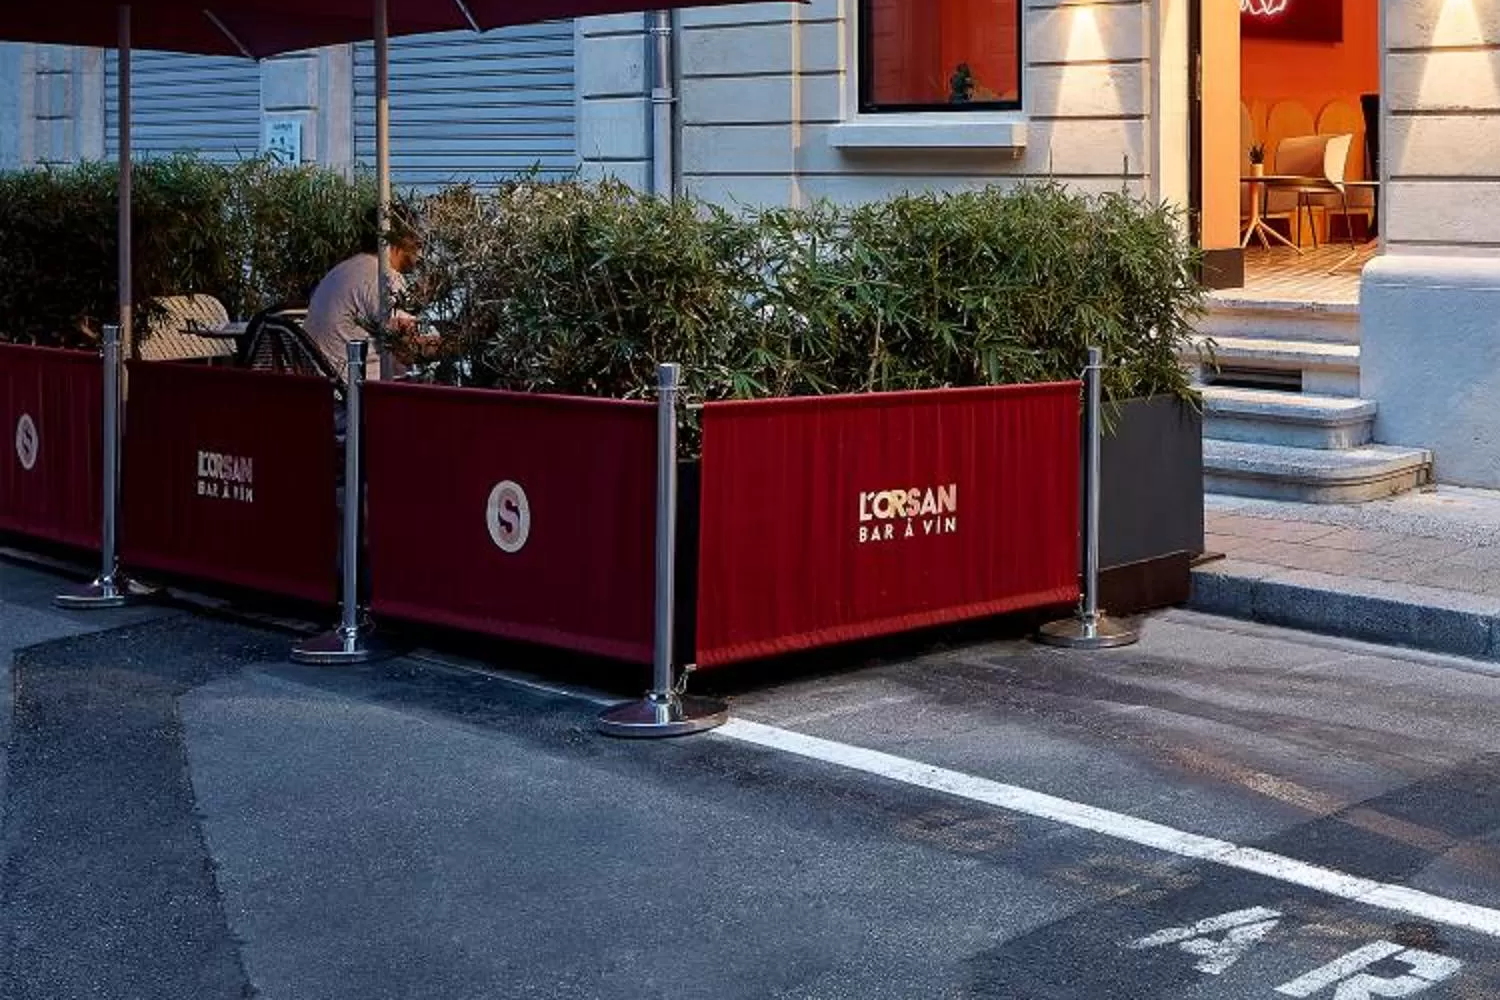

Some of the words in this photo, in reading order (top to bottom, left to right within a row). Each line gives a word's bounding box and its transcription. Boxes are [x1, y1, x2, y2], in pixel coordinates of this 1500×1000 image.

[860, 484, 957, 520] L'ORSAN
[859, 523, 895, 543] BAR
[923, 515, 957, 536] VIN
